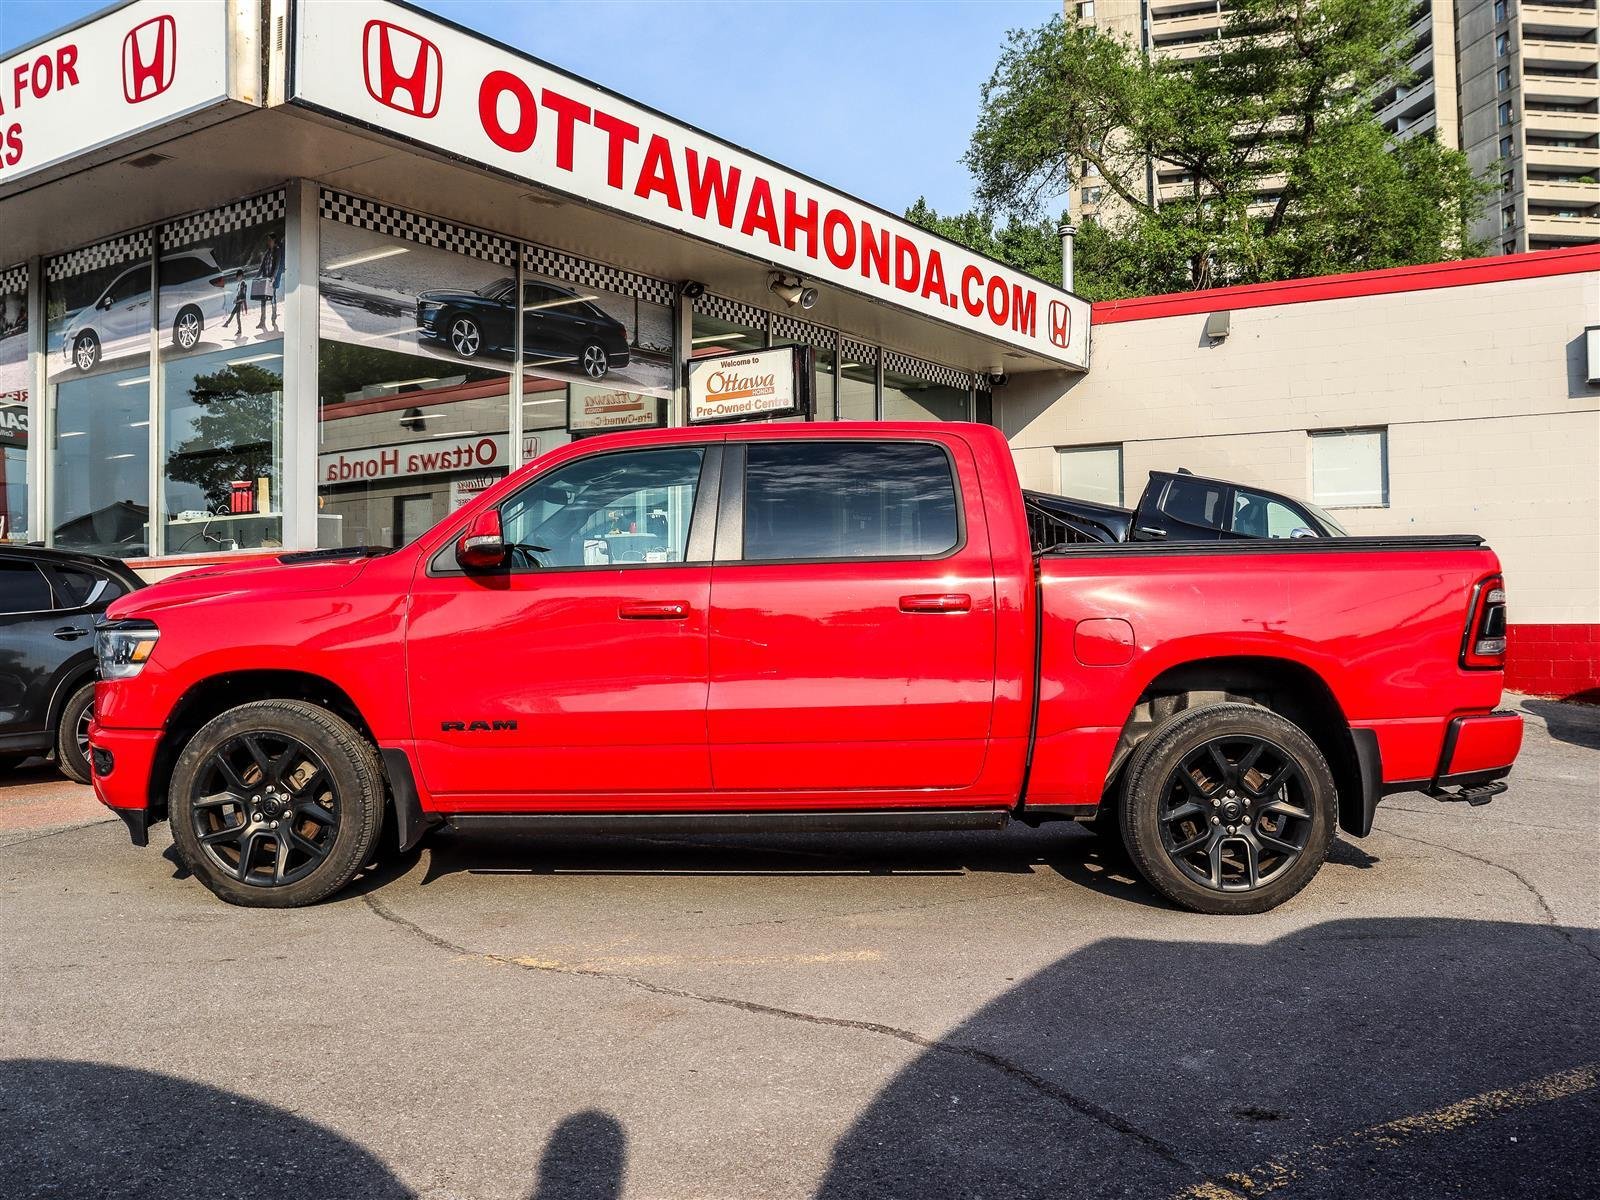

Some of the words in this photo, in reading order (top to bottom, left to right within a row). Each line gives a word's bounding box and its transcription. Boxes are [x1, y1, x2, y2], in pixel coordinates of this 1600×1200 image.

[13, 44, 80, 109] FOR
[478, 70, 1037, 338] OTTAWAHONDA.COM
[720, 359, 751, 369] Welcome
[752, 357, 760, 365] to
[706, 371, 776, 394] Ottawa
[752, 386, 775, 396] HONDA
[696, 400, 752, 417] Pre-Owned
[755, 397, 789, 410] Centre
[441, 720, 518, 731] RAM
